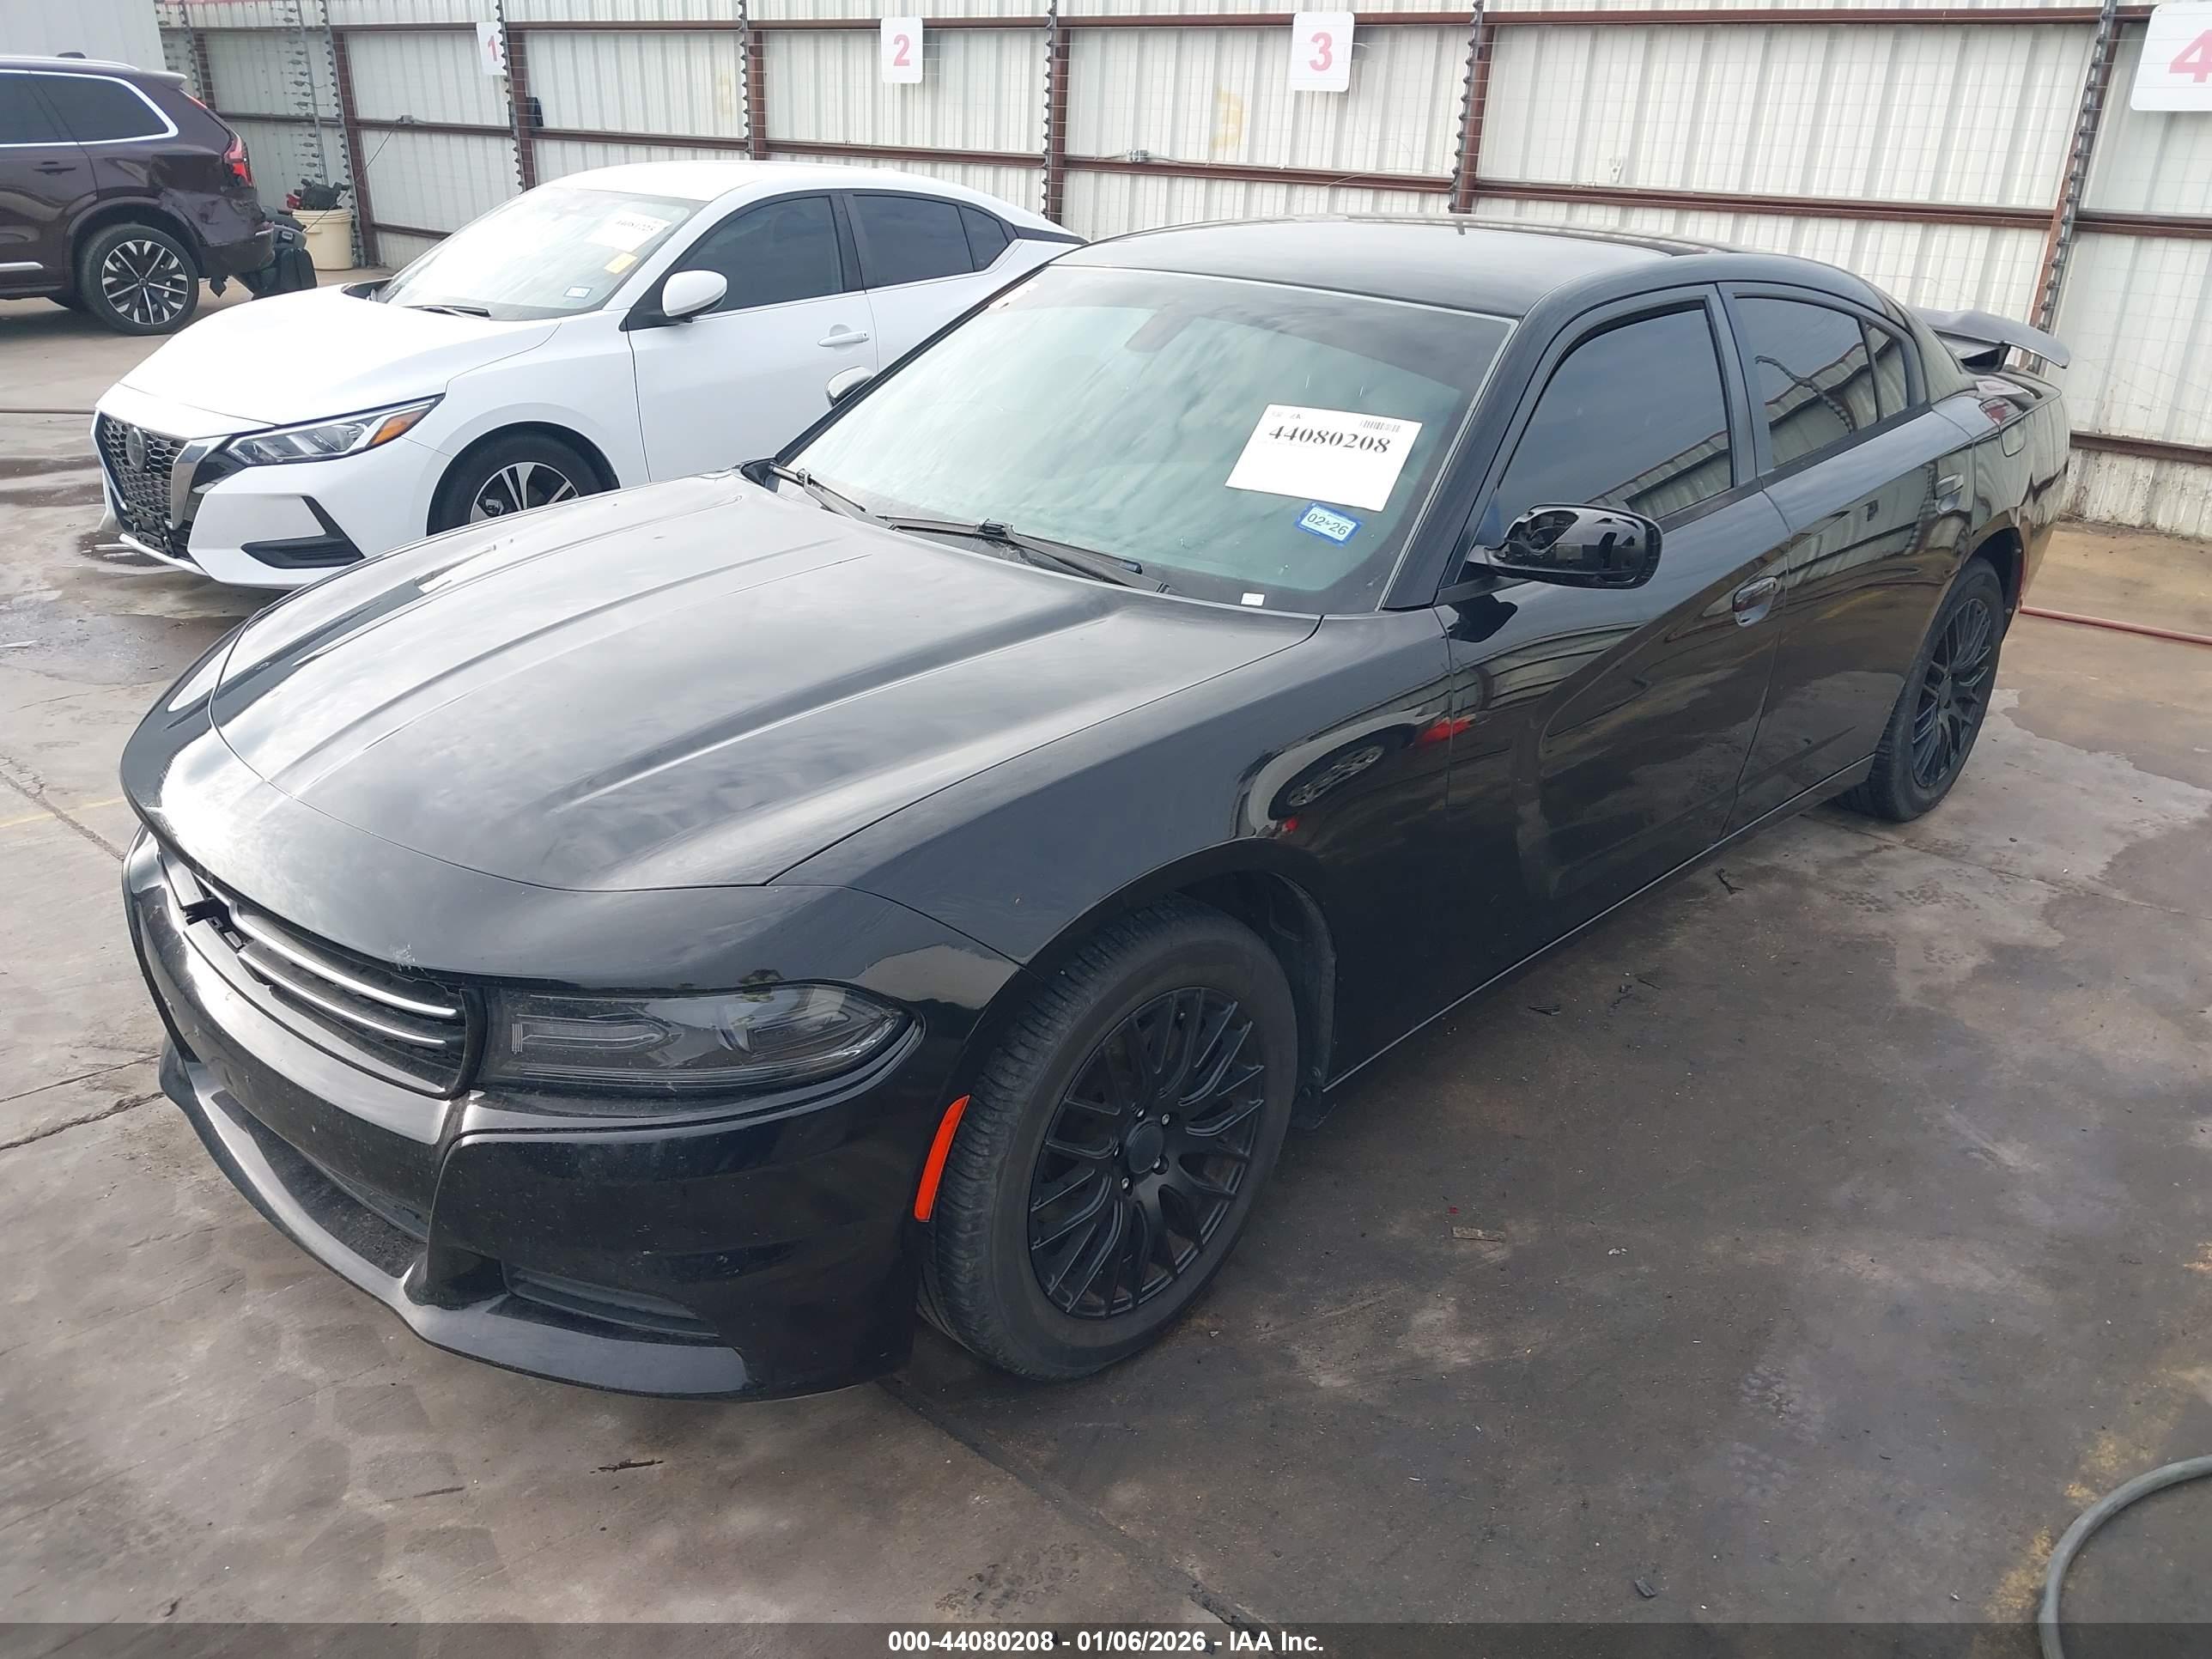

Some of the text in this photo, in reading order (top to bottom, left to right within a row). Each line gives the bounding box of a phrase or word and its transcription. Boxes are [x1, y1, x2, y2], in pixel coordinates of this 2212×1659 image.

[487, 34, 498, 62] 1
[893, 33, 910, 66] 2
[1309, 32, 1333, 71] 3
[2168, 28, 2212, 83] 4
[1268, 425, 1391, 453] 44080208
